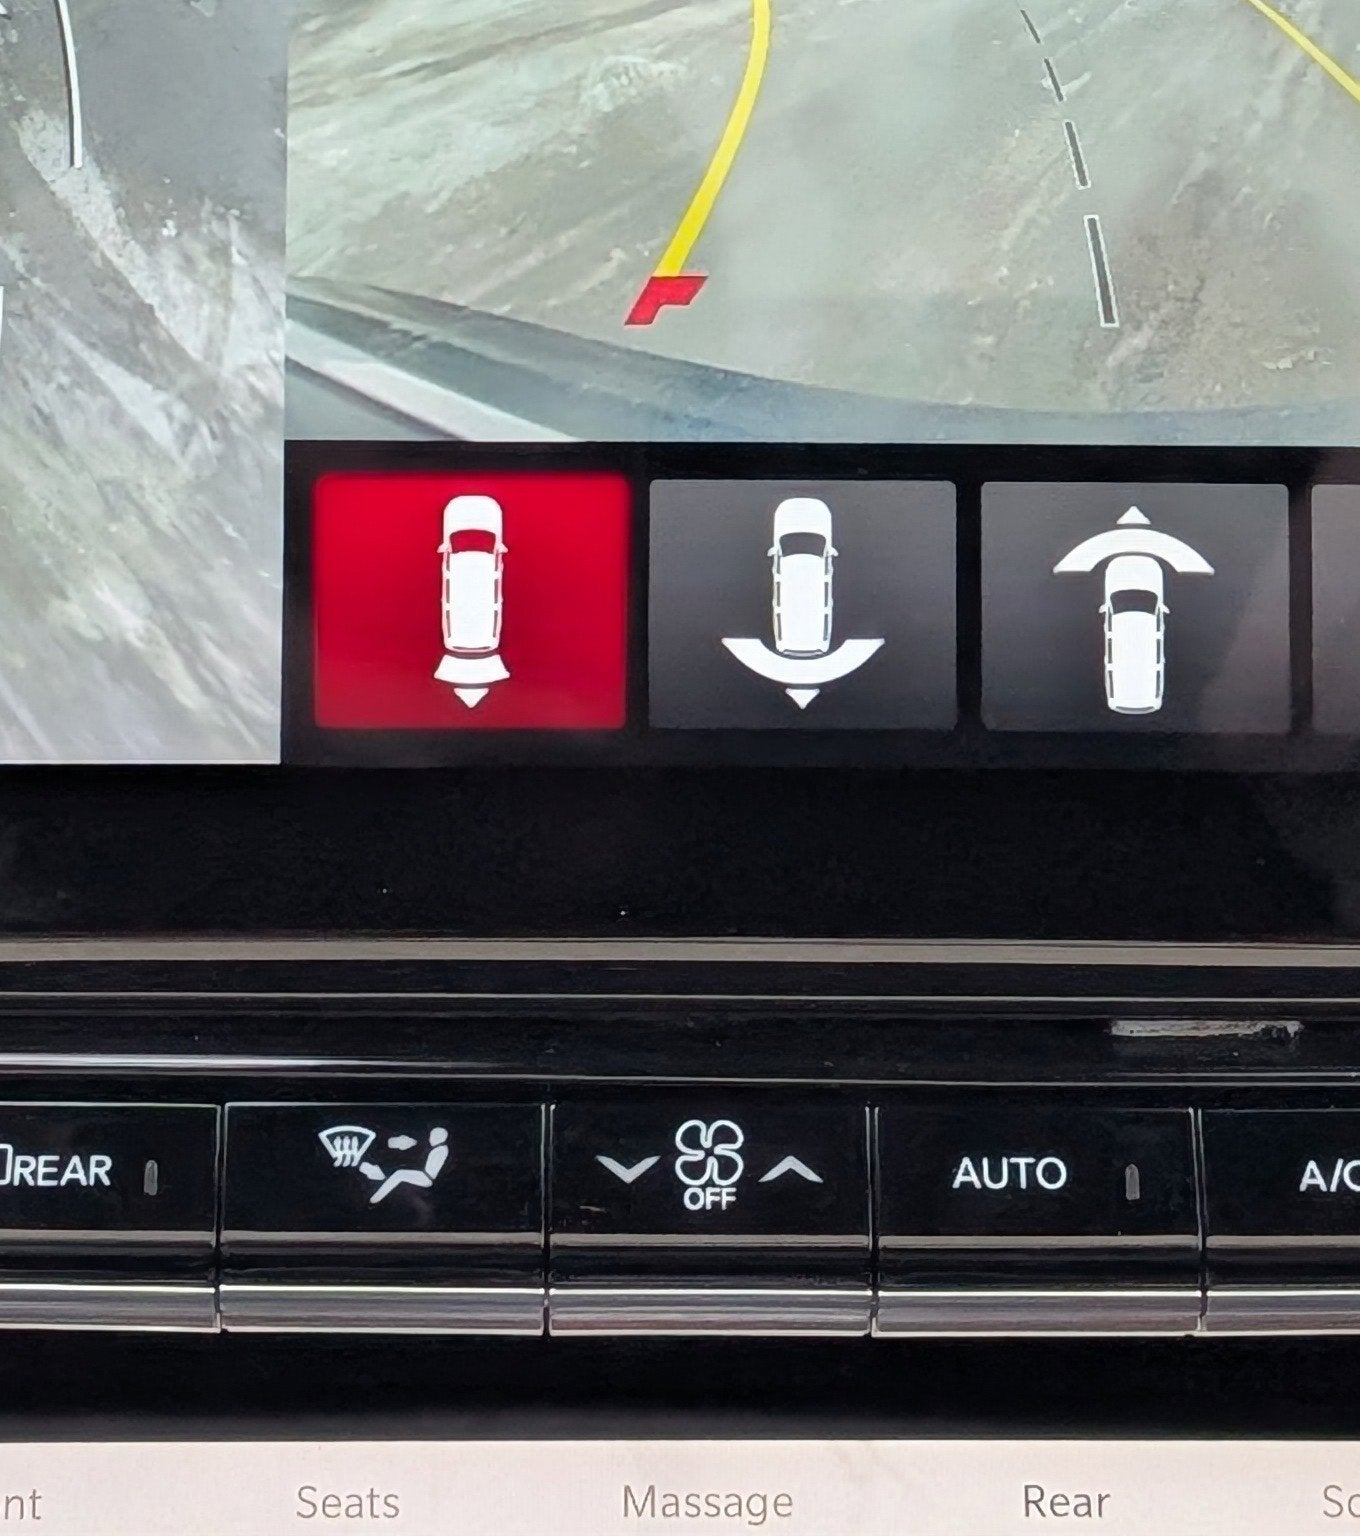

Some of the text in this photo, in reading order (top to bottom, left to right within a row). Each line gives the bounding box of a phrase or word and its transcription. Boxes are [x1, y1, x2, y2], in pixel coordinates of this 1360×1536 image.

[13, 1154, 113, 1187] REAR
[952, 1156, 1067, 1190] AUTO
[683, 1186, 737, 1211] OFF
[296, 1485, 400, 1519] Seats
[623, 1484, 793, 1528] Massage
[1024, 1484, 1111, 1518] Rear
